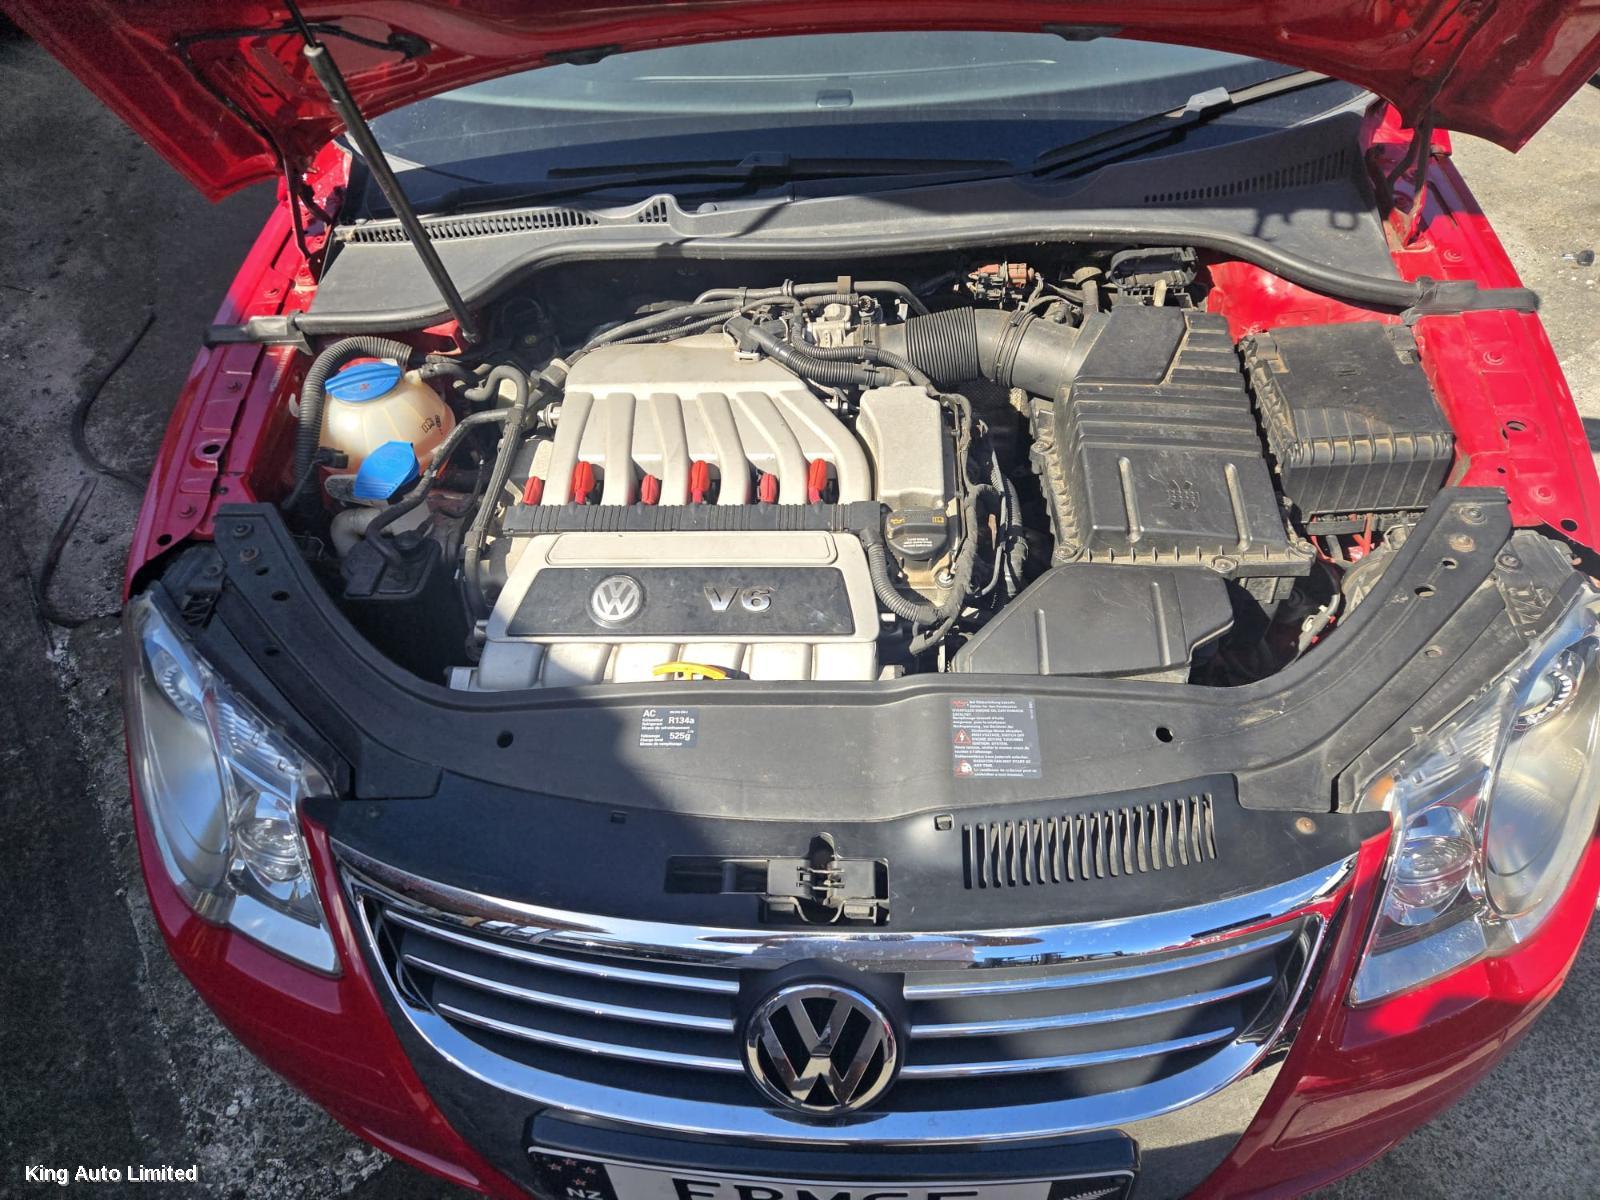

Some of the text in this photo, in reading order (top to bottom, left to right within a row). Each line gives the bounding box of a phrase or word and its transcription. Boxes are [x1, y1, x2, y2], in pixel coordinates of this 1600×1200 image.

[703, 585, 774, 612] V6
[642, 709, 656, 717] AC
[668, 716, 695, 724] R134a
[669, 731, 691, 741] 525g
[746, 984, 897, 1115] VW
[566, 1187, 603, 1200] NZ
